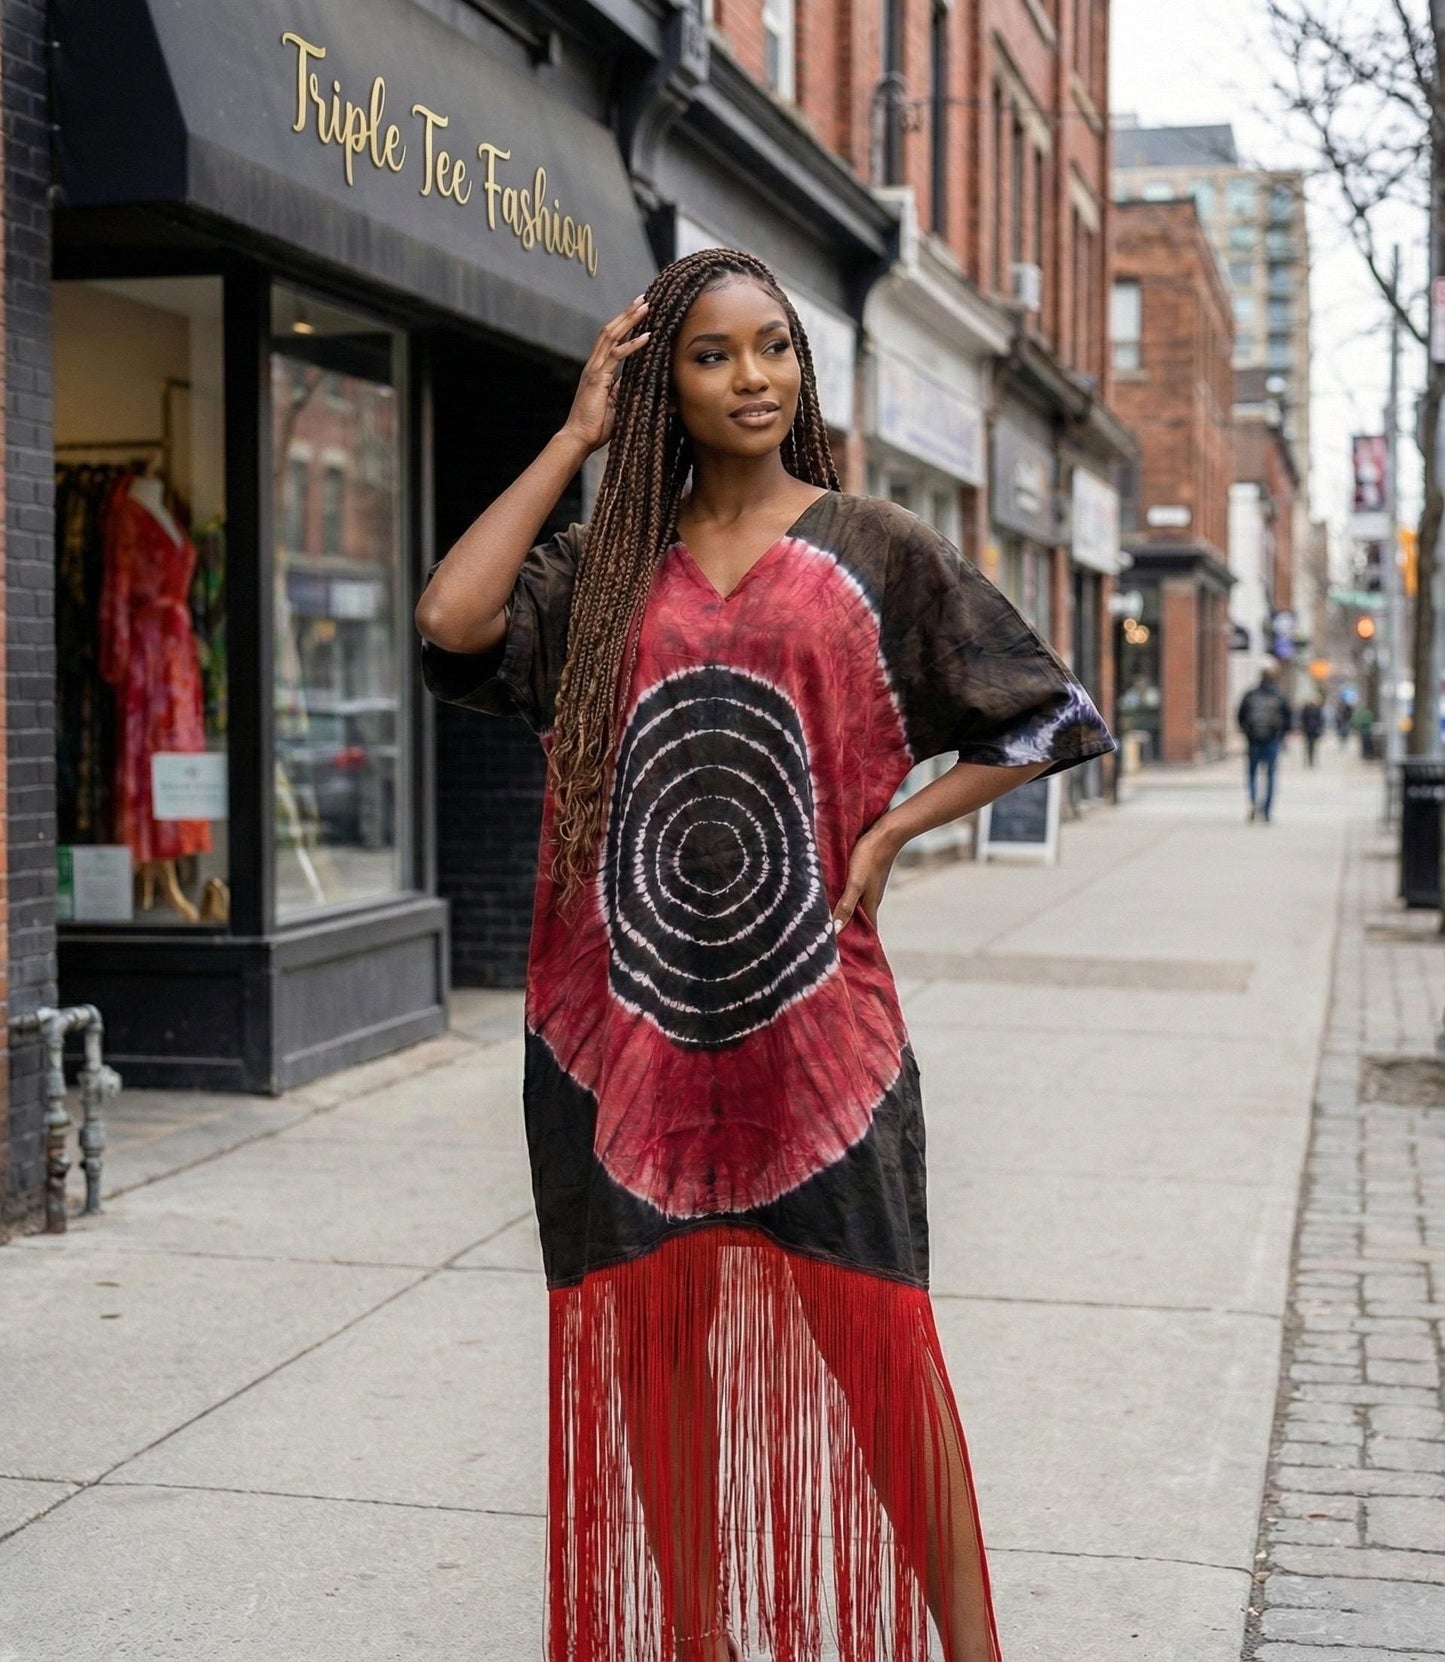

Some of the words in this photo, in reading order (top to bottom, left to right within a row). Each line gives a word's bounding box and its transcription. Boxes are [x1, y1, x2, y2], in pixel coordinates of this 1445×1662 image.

[281, 31, 407, 187] Triple
[411, 103, 473, 206] Tee
[477, 141, 599, 278] Fashion
